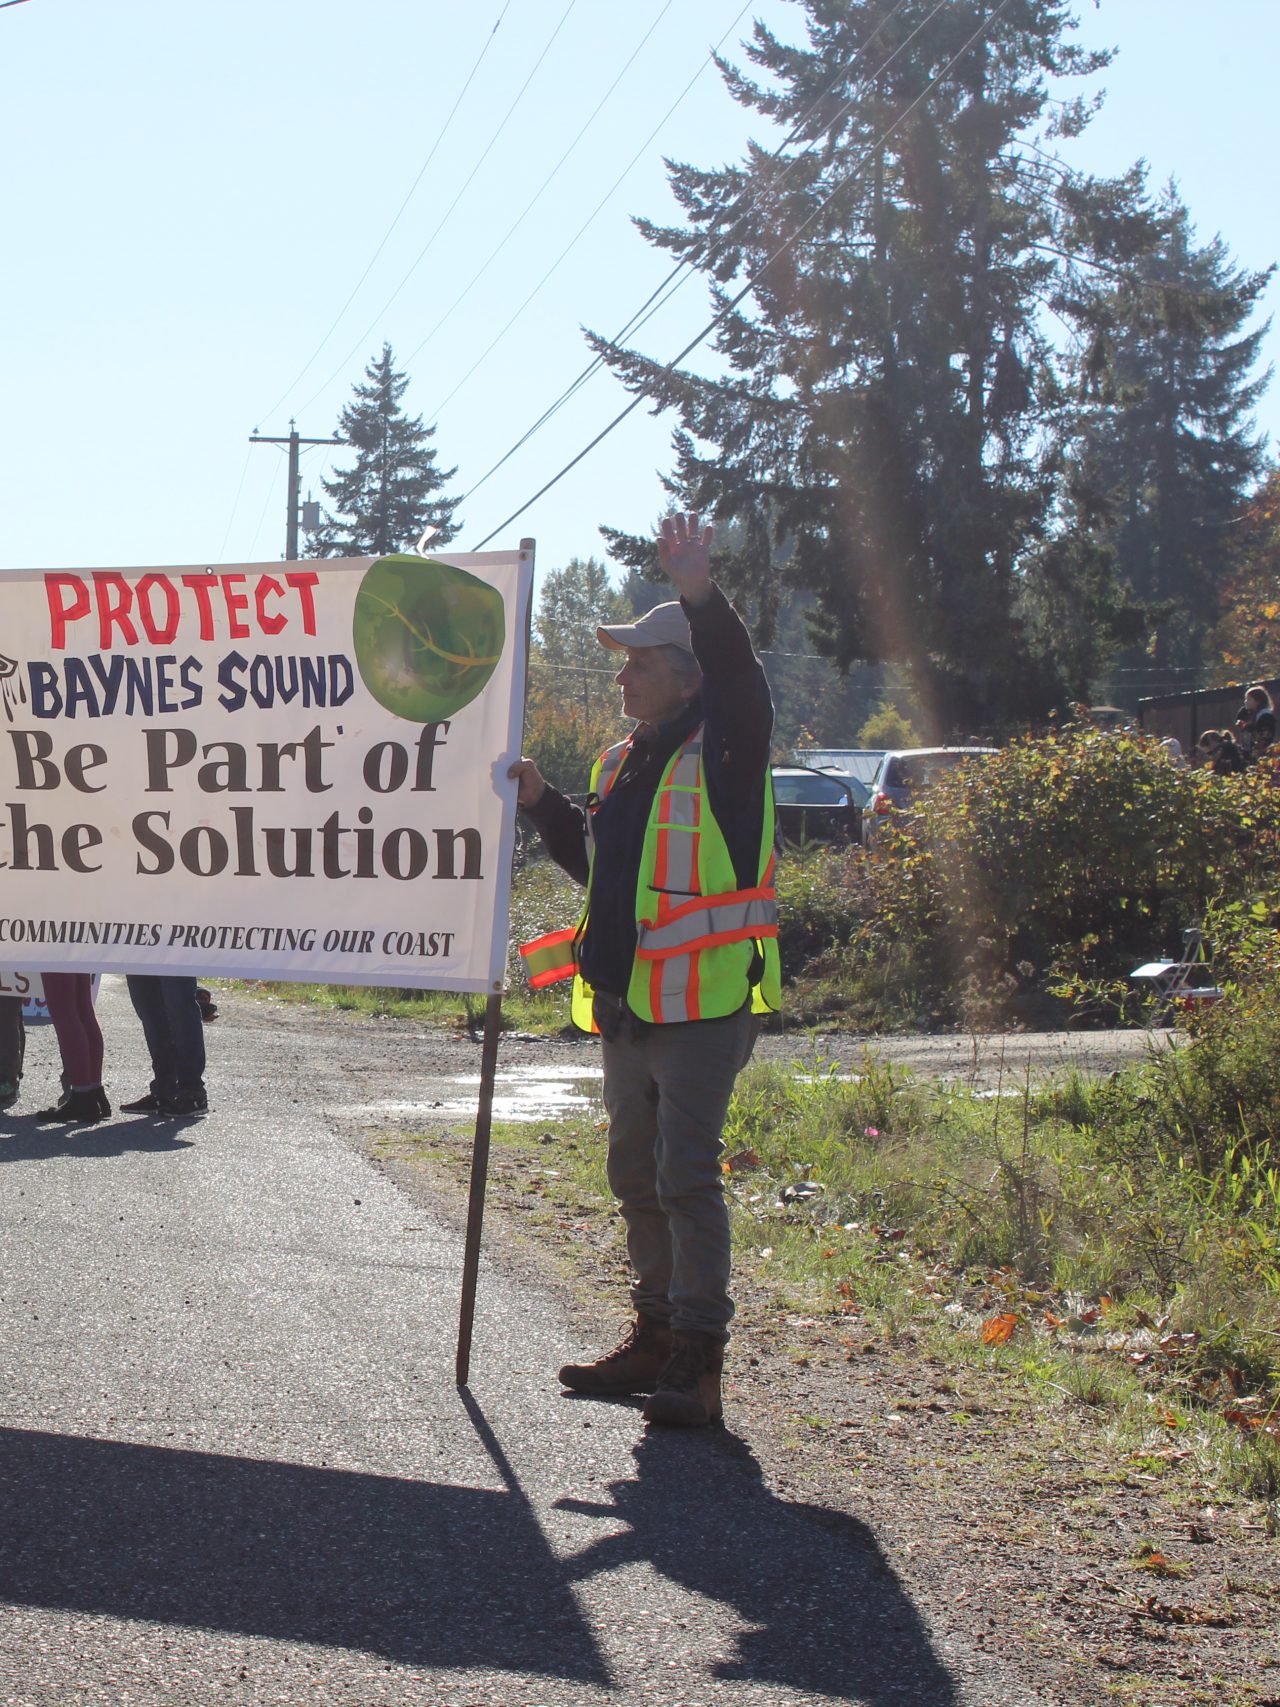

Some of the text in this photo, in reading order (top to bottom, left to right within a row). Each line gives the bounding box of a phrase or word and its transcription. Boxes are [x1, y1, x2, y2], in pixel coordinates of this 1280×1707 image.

[43, 571, 320, 650] PROTECT
[26, 650, 355, 719] BAYNES SOUND
[6, 729, 109, 793] Be
[362, 720, 452, 793] of
[131, 805, 485, 881] Solution
[167, 924, 317, 952] PROTECTING
[322, 929, 374, 954] OUR
[381, 931, 455, 958] COAST
